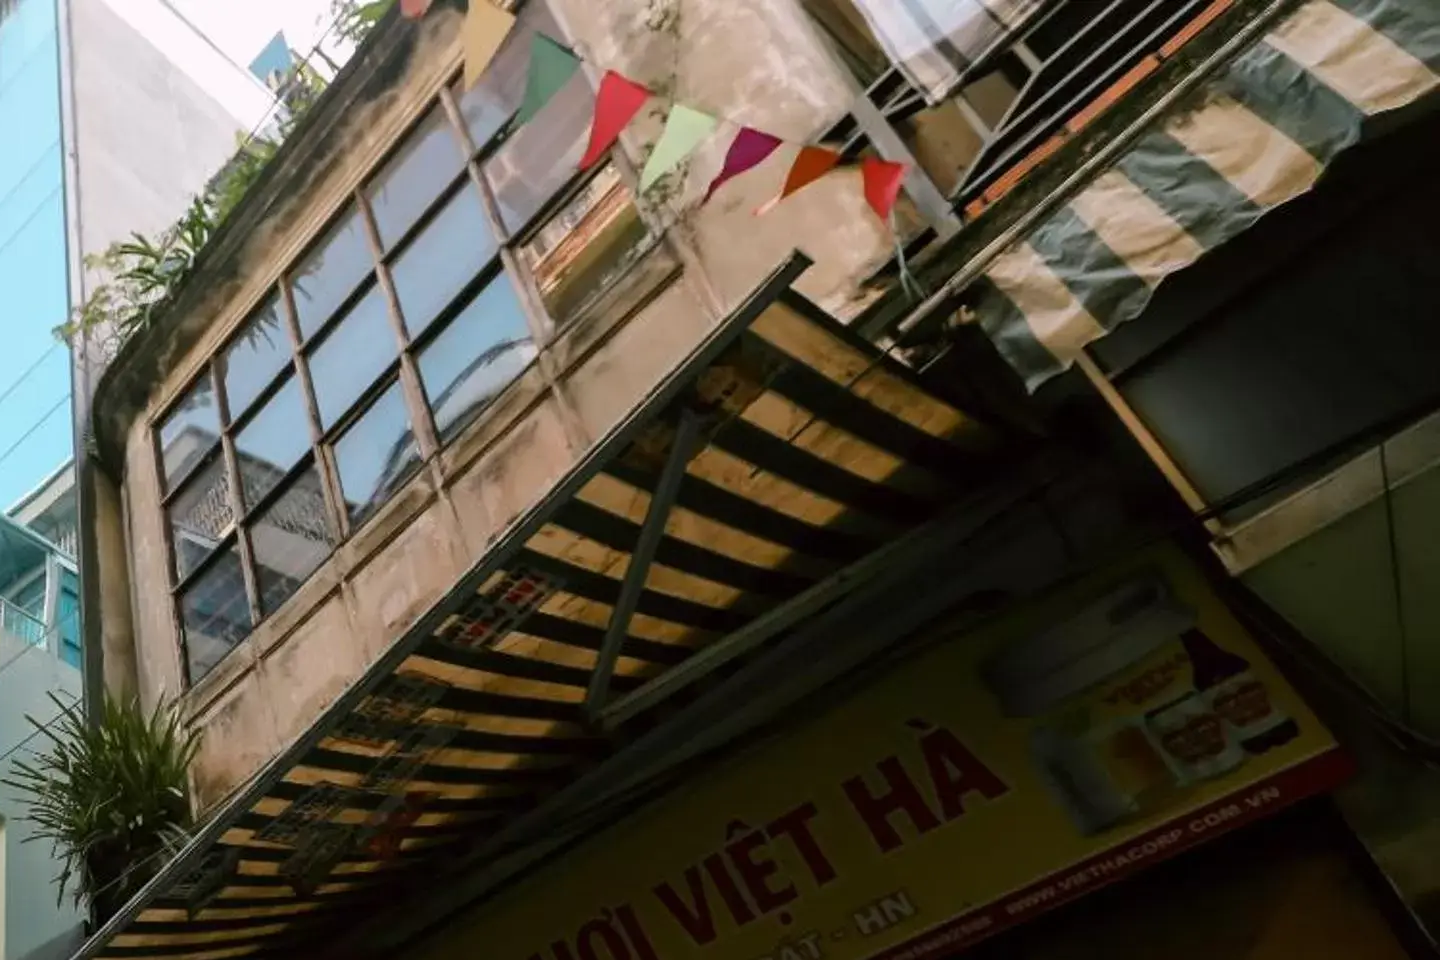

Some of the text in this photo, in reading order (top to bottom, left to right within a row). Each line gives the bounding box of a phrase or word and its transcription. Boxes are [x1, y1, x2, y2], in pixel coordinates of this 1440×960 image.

[652, 802, 840, 948] VIỆT
[841, 717, 1012, 854] HÀ
[852, 890, 918, 938] HN
